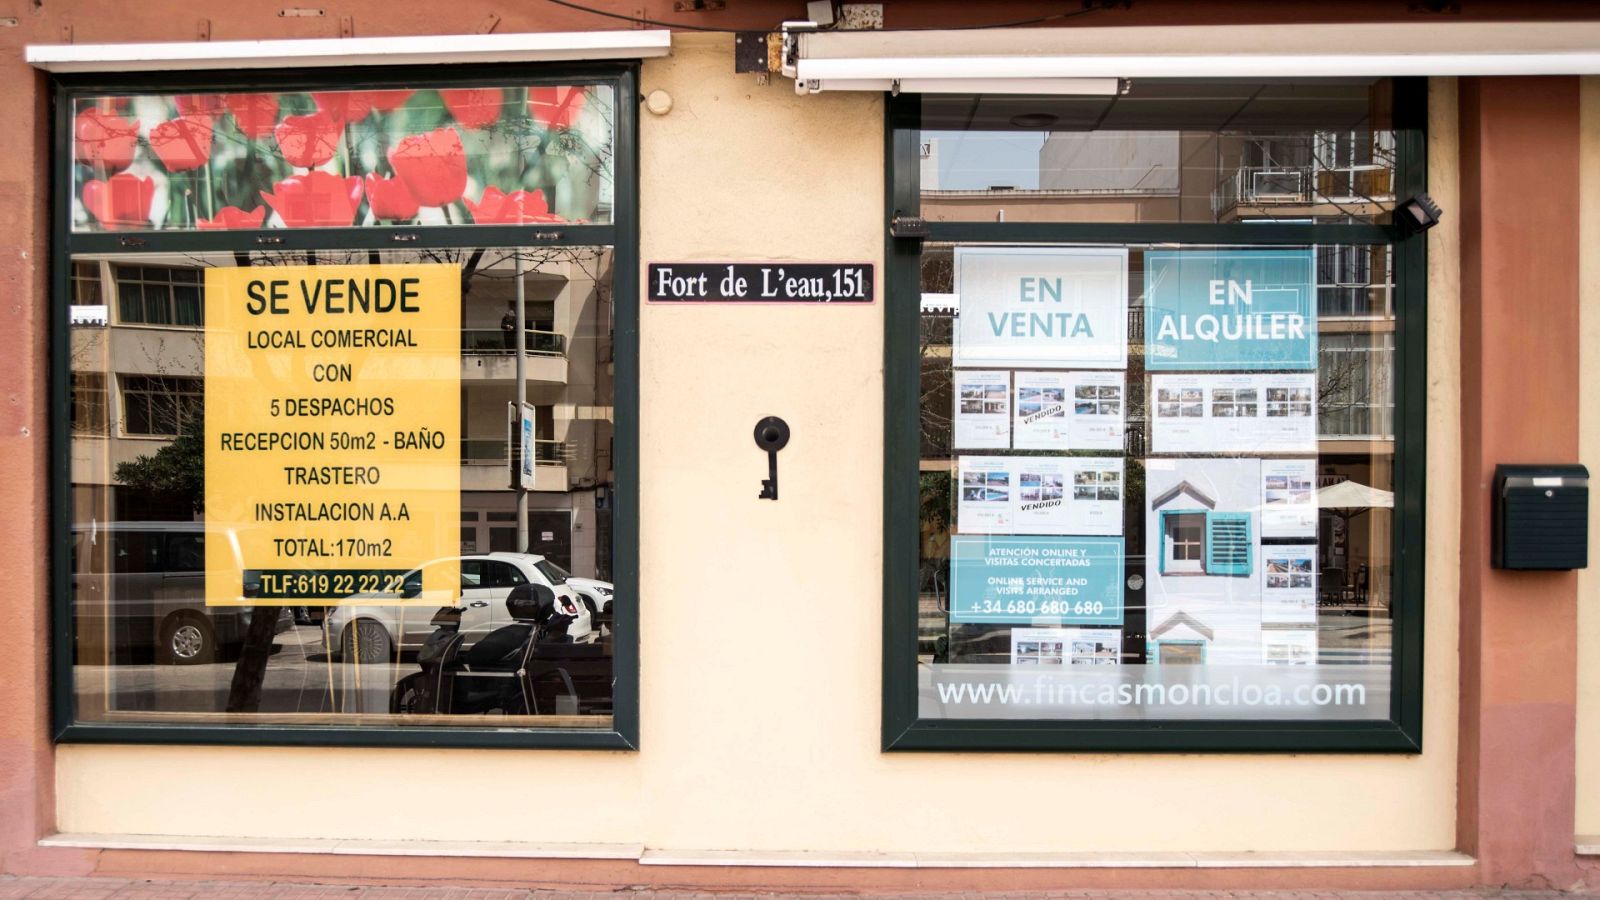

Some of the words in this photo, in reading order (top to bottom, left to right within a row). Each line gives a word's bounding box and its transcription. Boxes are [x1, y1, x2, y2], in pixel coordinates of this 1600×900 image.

[656, 267, 708, 297] Fort
[720, 265, 748, 297] de
[1019, 276, 1063, 303] EN
[246, 279, 290, 315] SE
[300, 278, 421, 314] VENDE
[1208, 279, 1253, 306] EN
[987, 311, 1094, 338] VENTA
[1156, 313, 1306, 342] ALQUILER
[247, 330, 307, 349] LOCAL
[311, 328, 418, 348] COMERCIAL
[312, 363, 352, 382] CON
[270, 398, 280, 417] 5
[285, 397, 394, 416] DESPACHOS
[1023, 404, 1063, 425] VENDIDO
[220, 432, 325, 451] RECEPCION
[330, 431, 376, 450] 50m2
[394, 427, 445, 450] BAÑO
[284, 466, 380, 485] TRASTERO
[255, 502, 375, 521] INSTALACION
[379, 502, 410, 521] A.A
[1020, 499, 1062, 512] VENDIDO
[273, 538, 392, 557] TOTAL:170m2
[988, 547, 1039, 557] ATENCIÓN
[1041, 549, 1078, 557] ONLINE
[1079, 549, 1087, 557] Y
[984, 558, 1019, 566] VISITAS
[1021, 558, 1091, 567] CONCERTADAS
[260, 574, 329, 594] TLF:619
[333, 574, 355, 594] 22
[359, 574, 379, 594] 22
[384, 574, 405, 594] 22
[987, 577, 1024, 586] ONLINE
[1026, 577, 1063, 586] SERVICE
[1065, 577, 1088, 586] AND
[996, 586, 1024, 595] VISITS
[1026, 586, 1078, 595] ARRANGED
[971, 600, 1002, 614] +34
[1007, 600, 1036, 614] 680
[1040, 600, 1069, 614] 680
[1074, 600, 1103, 614] 680
[937, 675, 1366, 707] www.fincasmoncloa.com
